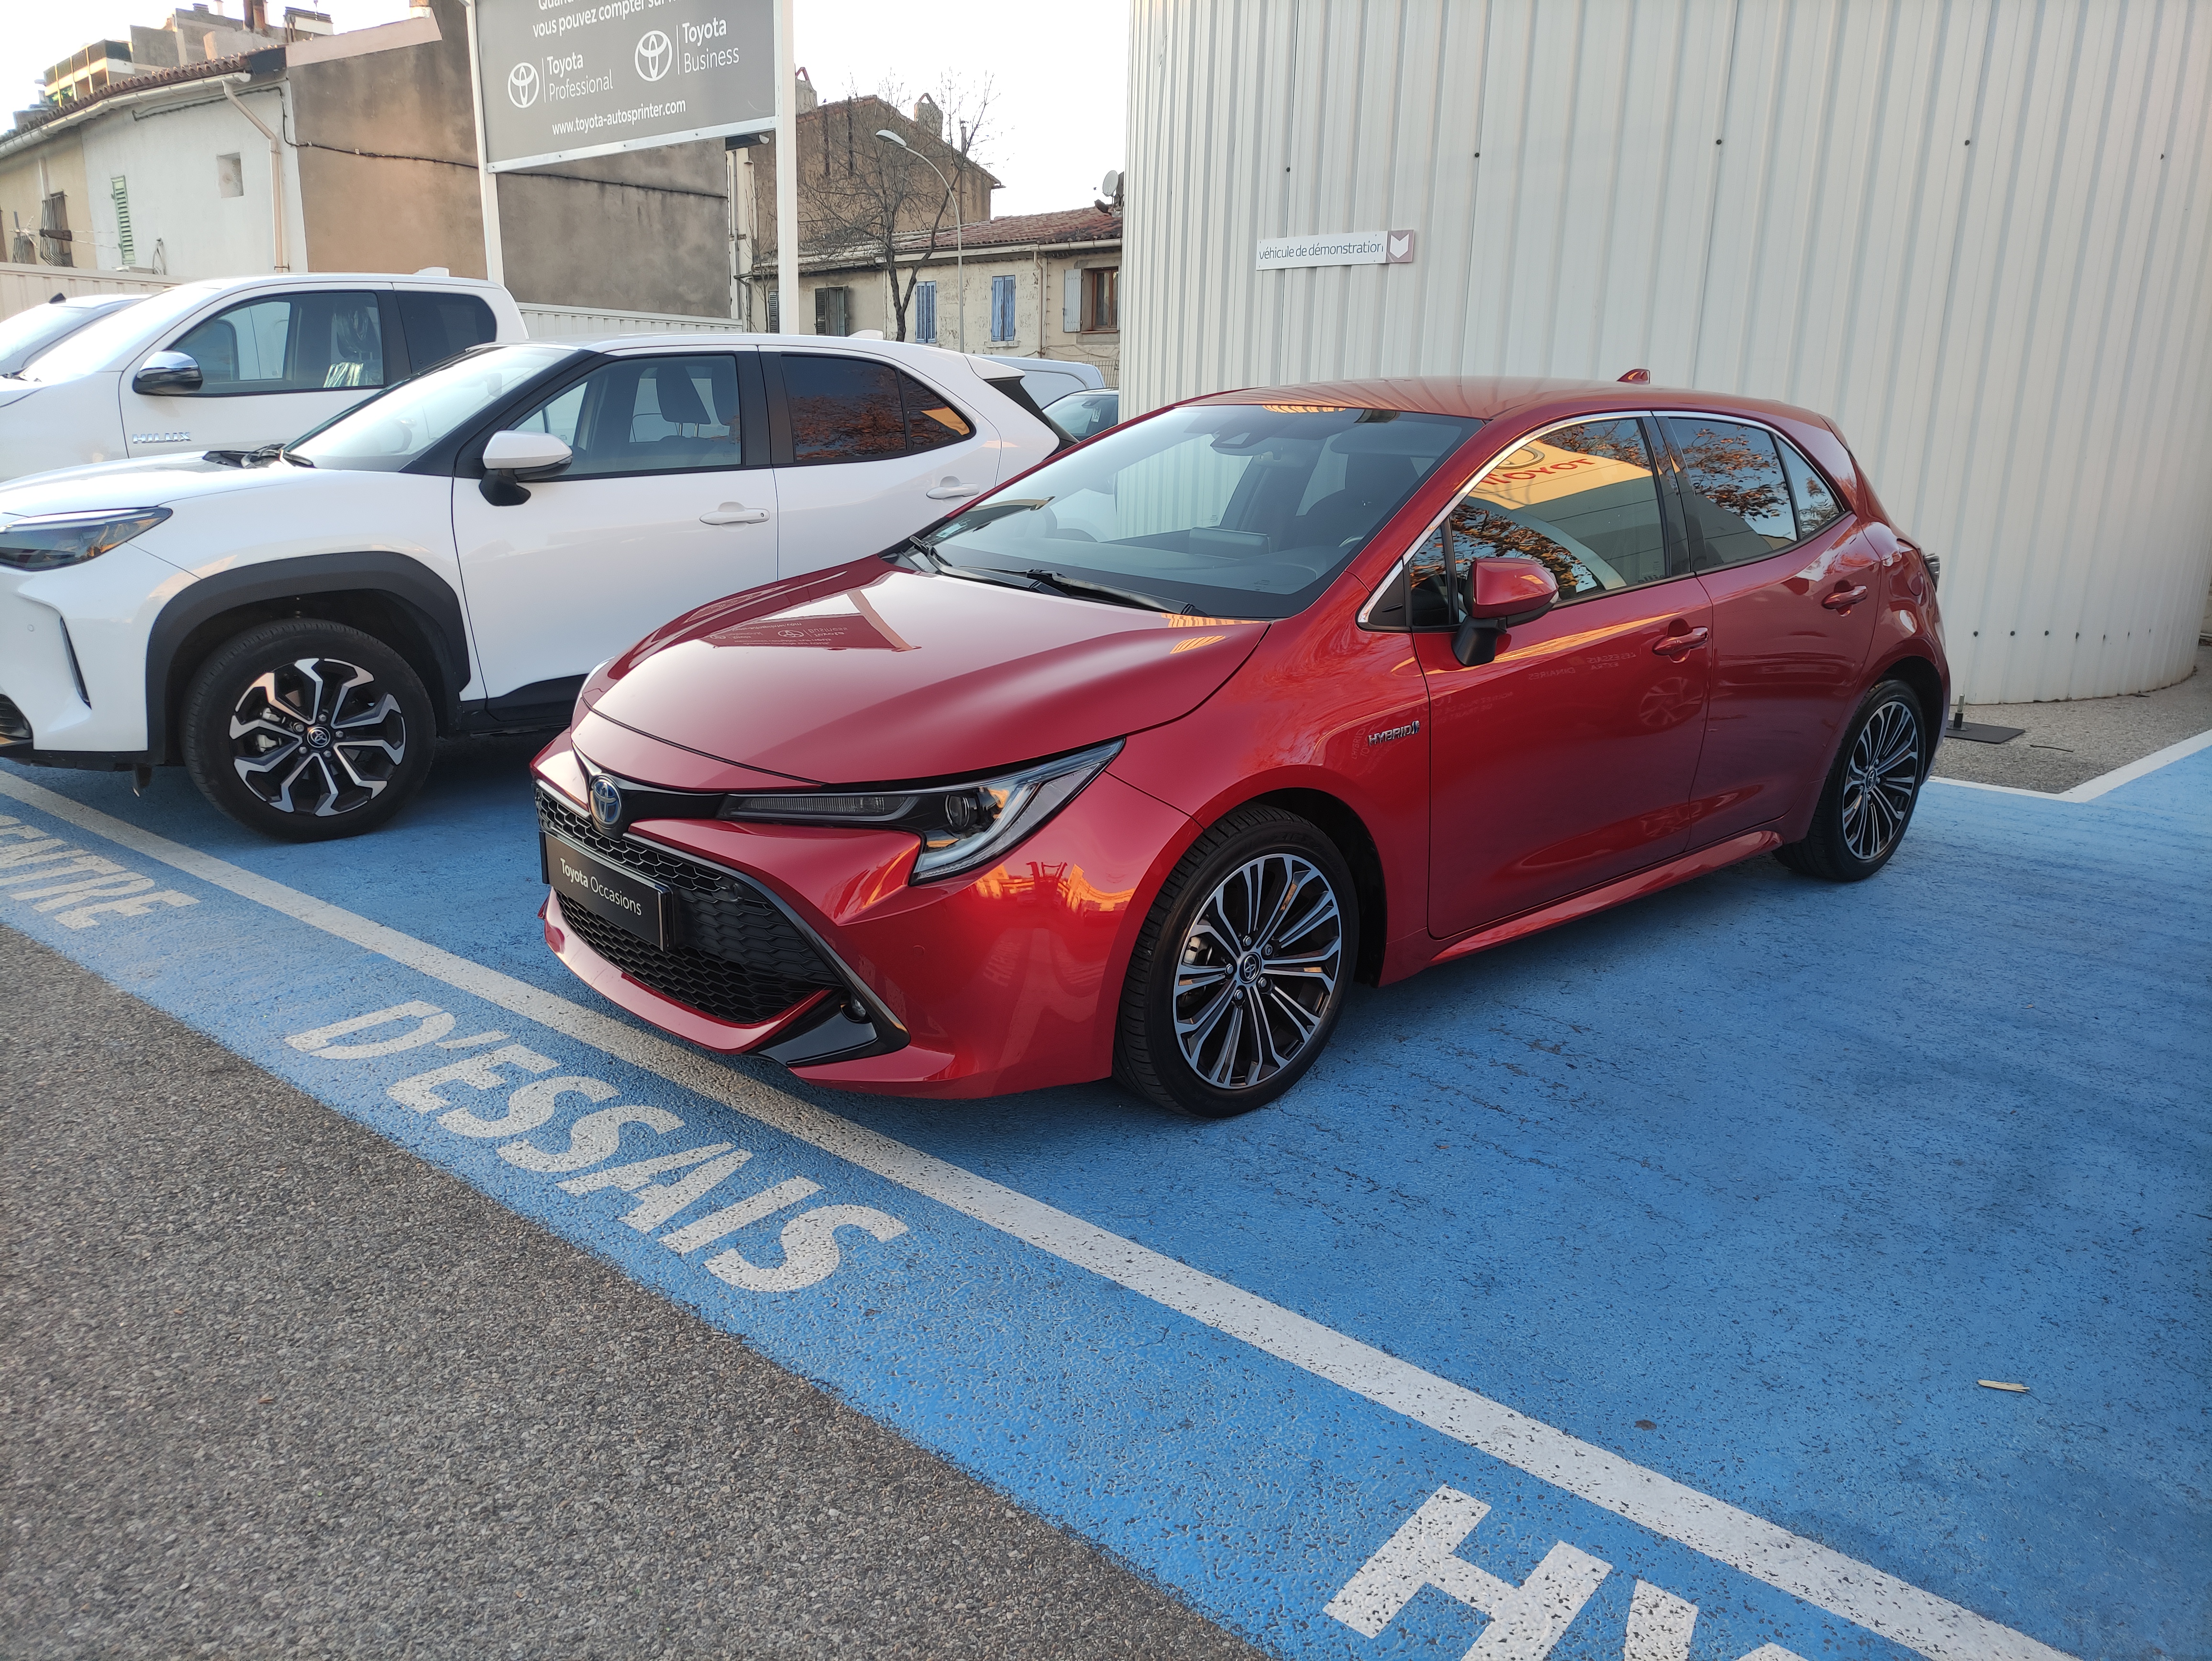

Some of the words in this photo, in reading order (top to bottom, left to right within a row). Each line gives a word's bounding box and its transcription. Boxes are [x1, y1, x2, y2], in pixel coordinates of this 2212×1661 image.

[532, 19, 557, 38] vous
[559, 9, 597, 37] pouvez
[598, 0, 645, 20] compter
[682, 17, 727, 46] Toyota
[547, 52, 584, 76] Toyota
[684, 47, 740, 74] Business
[549, 69, 613, 102] Professional
[552, 99, 686, 135] www.toyota-autosprinter.com
[1259, 246, 1294, 260] véhicule
[1295, 245, 1307, 257] de
[1308, 241, 1383, 256] démonstration
[133, 432, 191, 443] HILUX
[1368, 724, 1412, 747] HYBRID
[560, 858, 588, 888] Toyota
[590, 876, 642, 916] Occasions
[284, 1000, 909, 1293] D'ESSAIS
